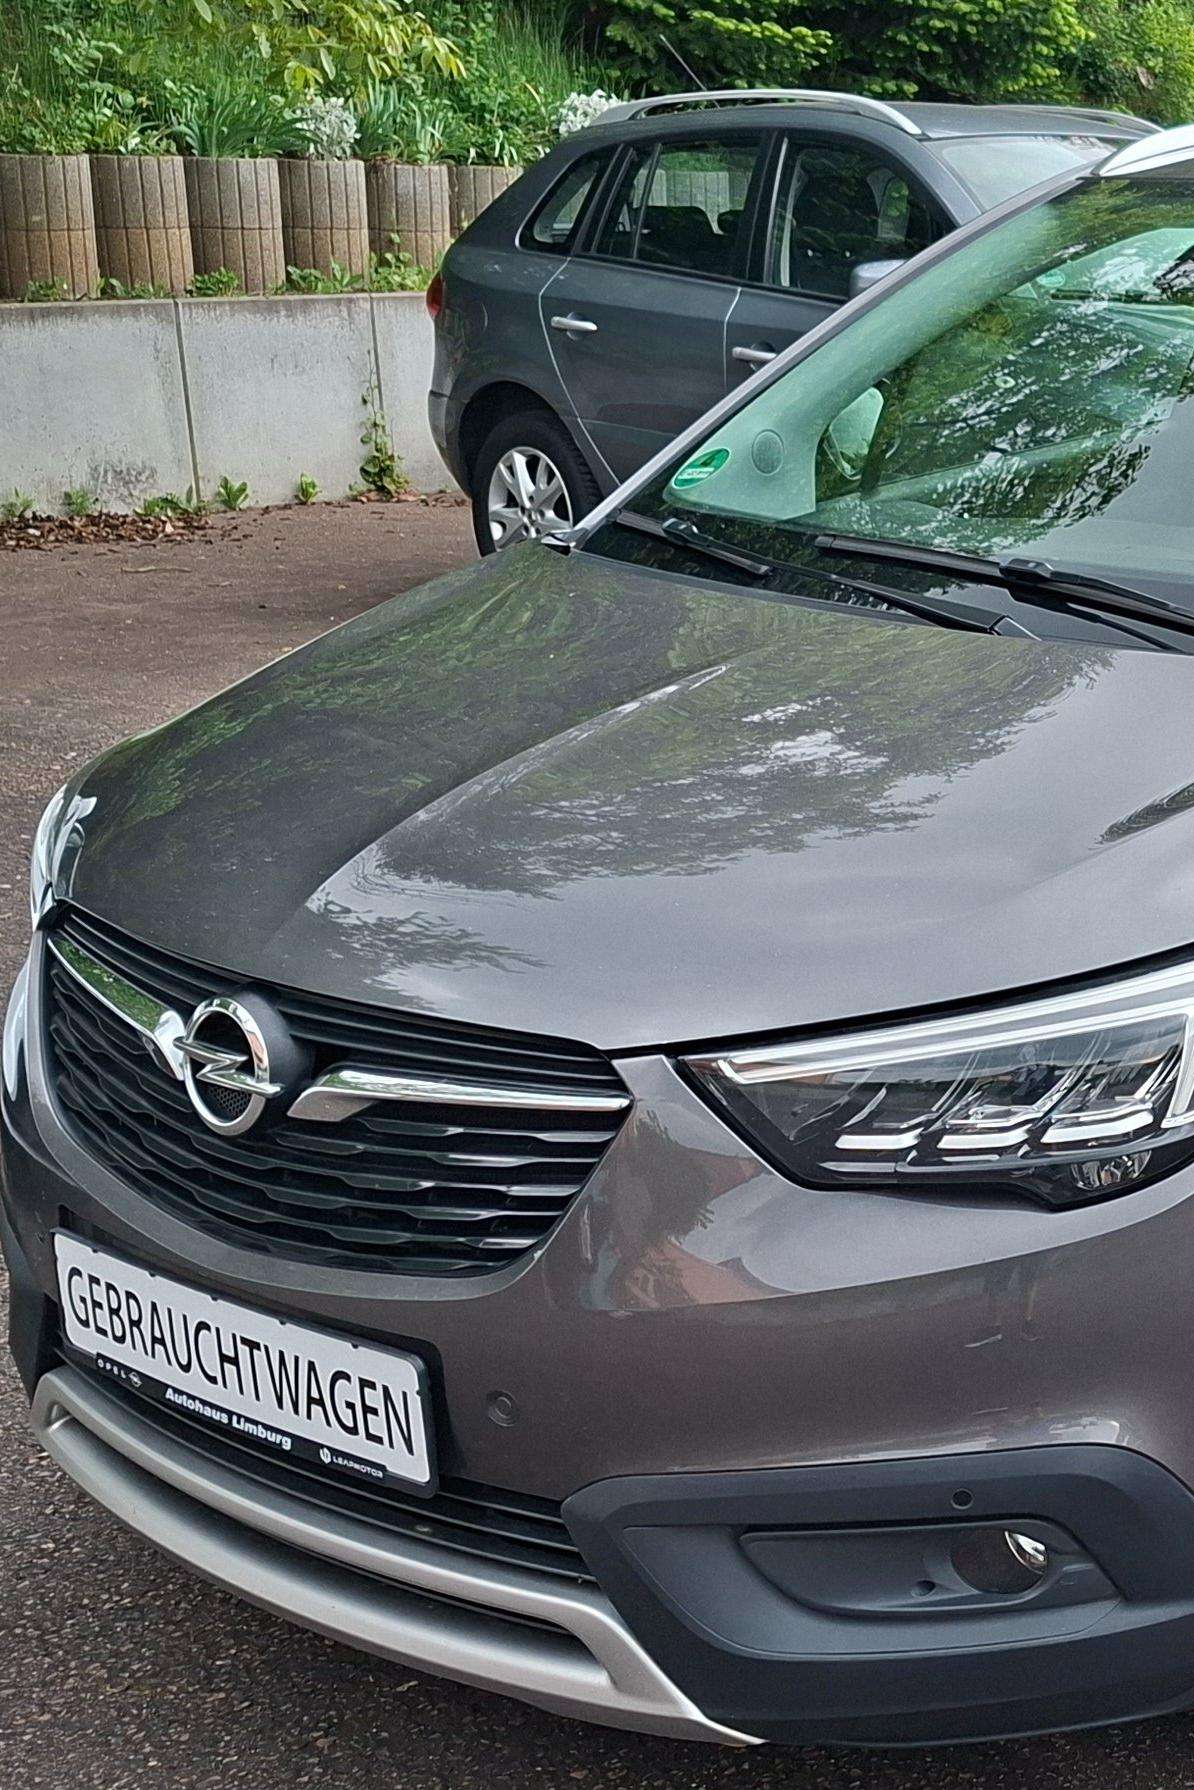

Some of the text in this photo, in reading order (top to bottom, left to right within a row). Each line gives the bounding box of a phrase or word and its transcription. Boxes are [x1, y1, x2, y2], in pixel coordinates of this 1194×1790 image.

[67, 1266, 415, 1456] GEBRAUCHTWAGEN
[165, 1388, 292, 1451] Autohaus Limburg
